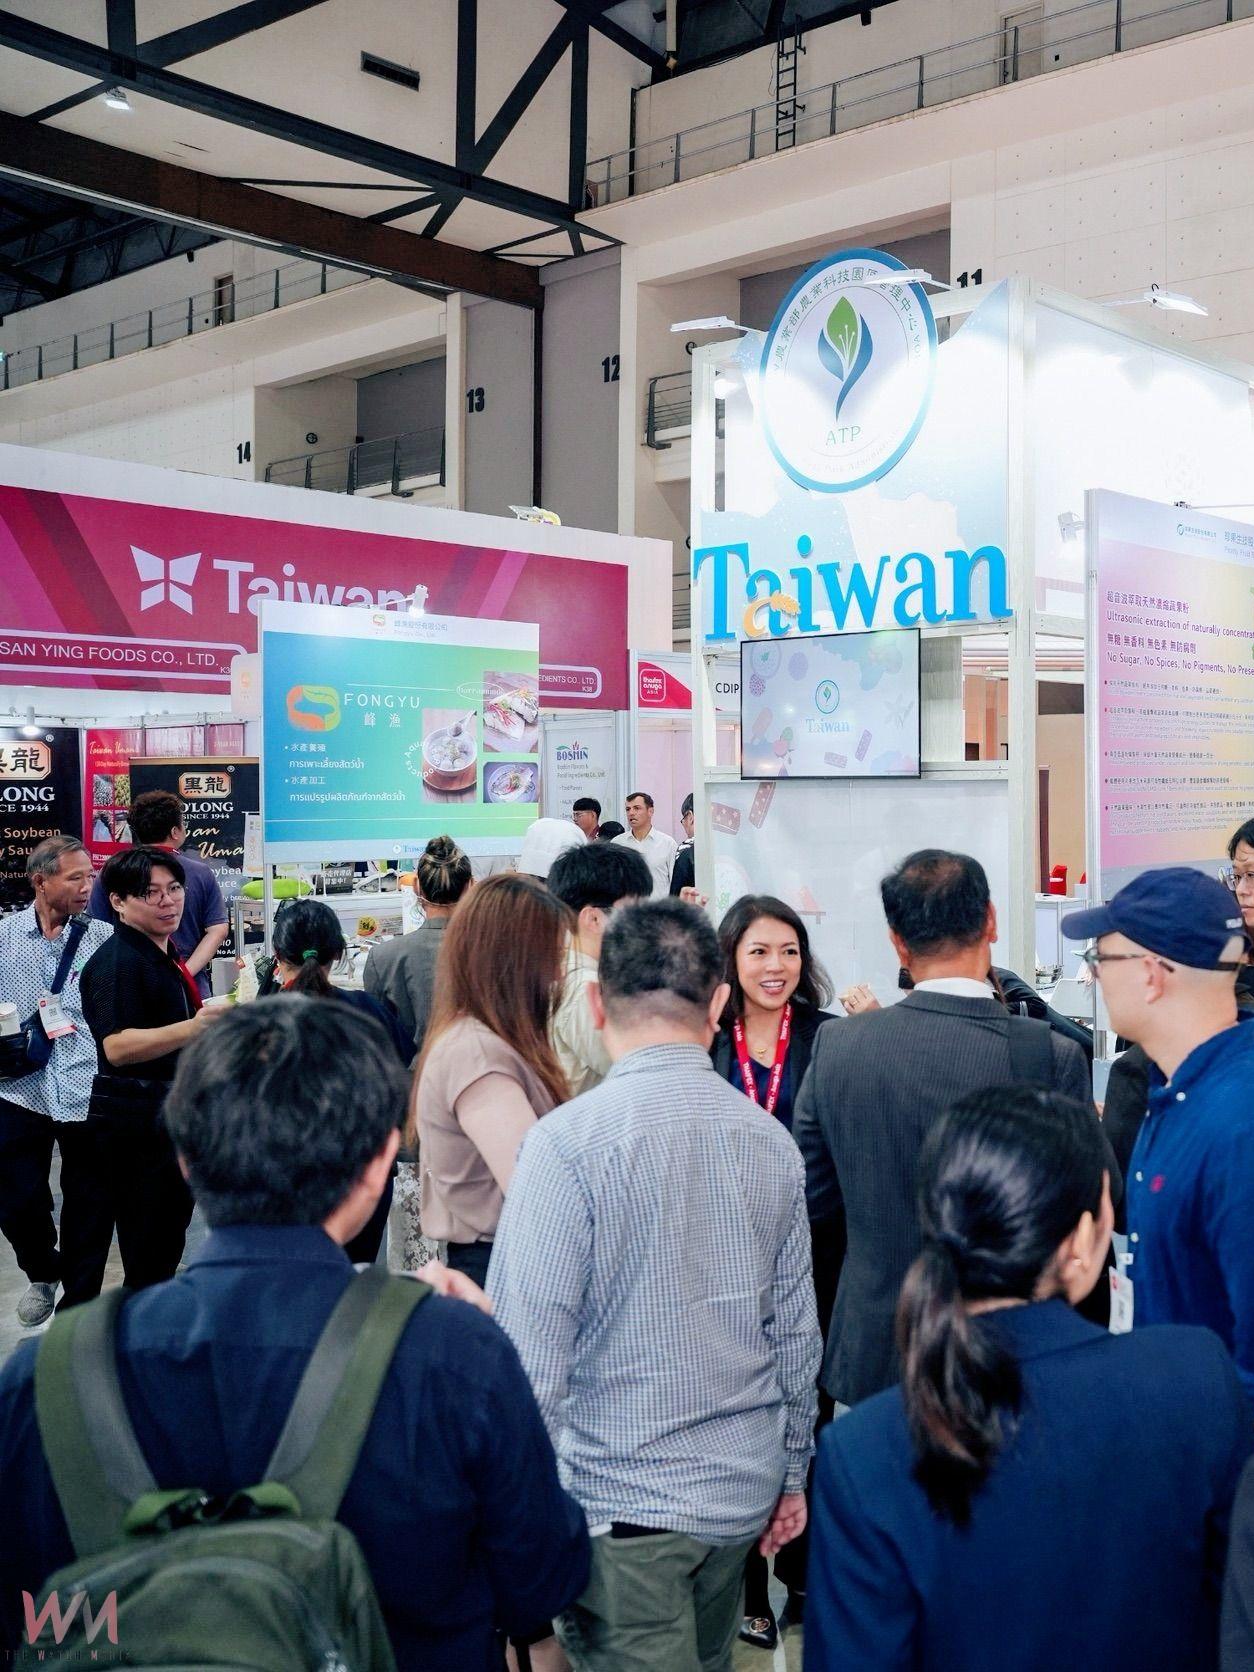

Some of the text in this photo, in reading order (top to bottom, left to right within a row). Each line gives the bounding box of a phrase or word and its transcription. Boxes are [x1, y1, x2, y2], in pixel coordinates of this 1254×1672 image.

[602, 354, 620, 383] 12
[466, 388, 485, 413] 13
[825, 425, 861, 446] ATP
[237, 441, 251, 464] 14
[693, 535, 1013, 641] Taiwan
[1107, 610, 1143, 625] Ultrasonic
[1146, 617, 1180, 630] extraction
[1183, 621, 1189, 630] of
[1192, 624, 1220, 637] naturally
[0, 642, 219, 666] SAN YING FOODS CO., LTD.
[1107, 652, 1116, 662] No
[1120, 653, 1142, 667] Sugar,
[1145, 656, 1154, 666] No
[1157, 657, 1180, 669] Spices,
[1183, 660, 1191, 670] No
[1194, 661, 1226, 673] Pigments,
[1228, 664, 1236, 674] No
[344, 694, 420, 709] FONGYU
[364, 712, 401, 727] 峰漁
[806, 718, 850, 733] Taiwan
[184, 776, 228, 794] 黑龍
[21, 803, 49, 812] 1944
[4, 827, 61, 840] Soybean
